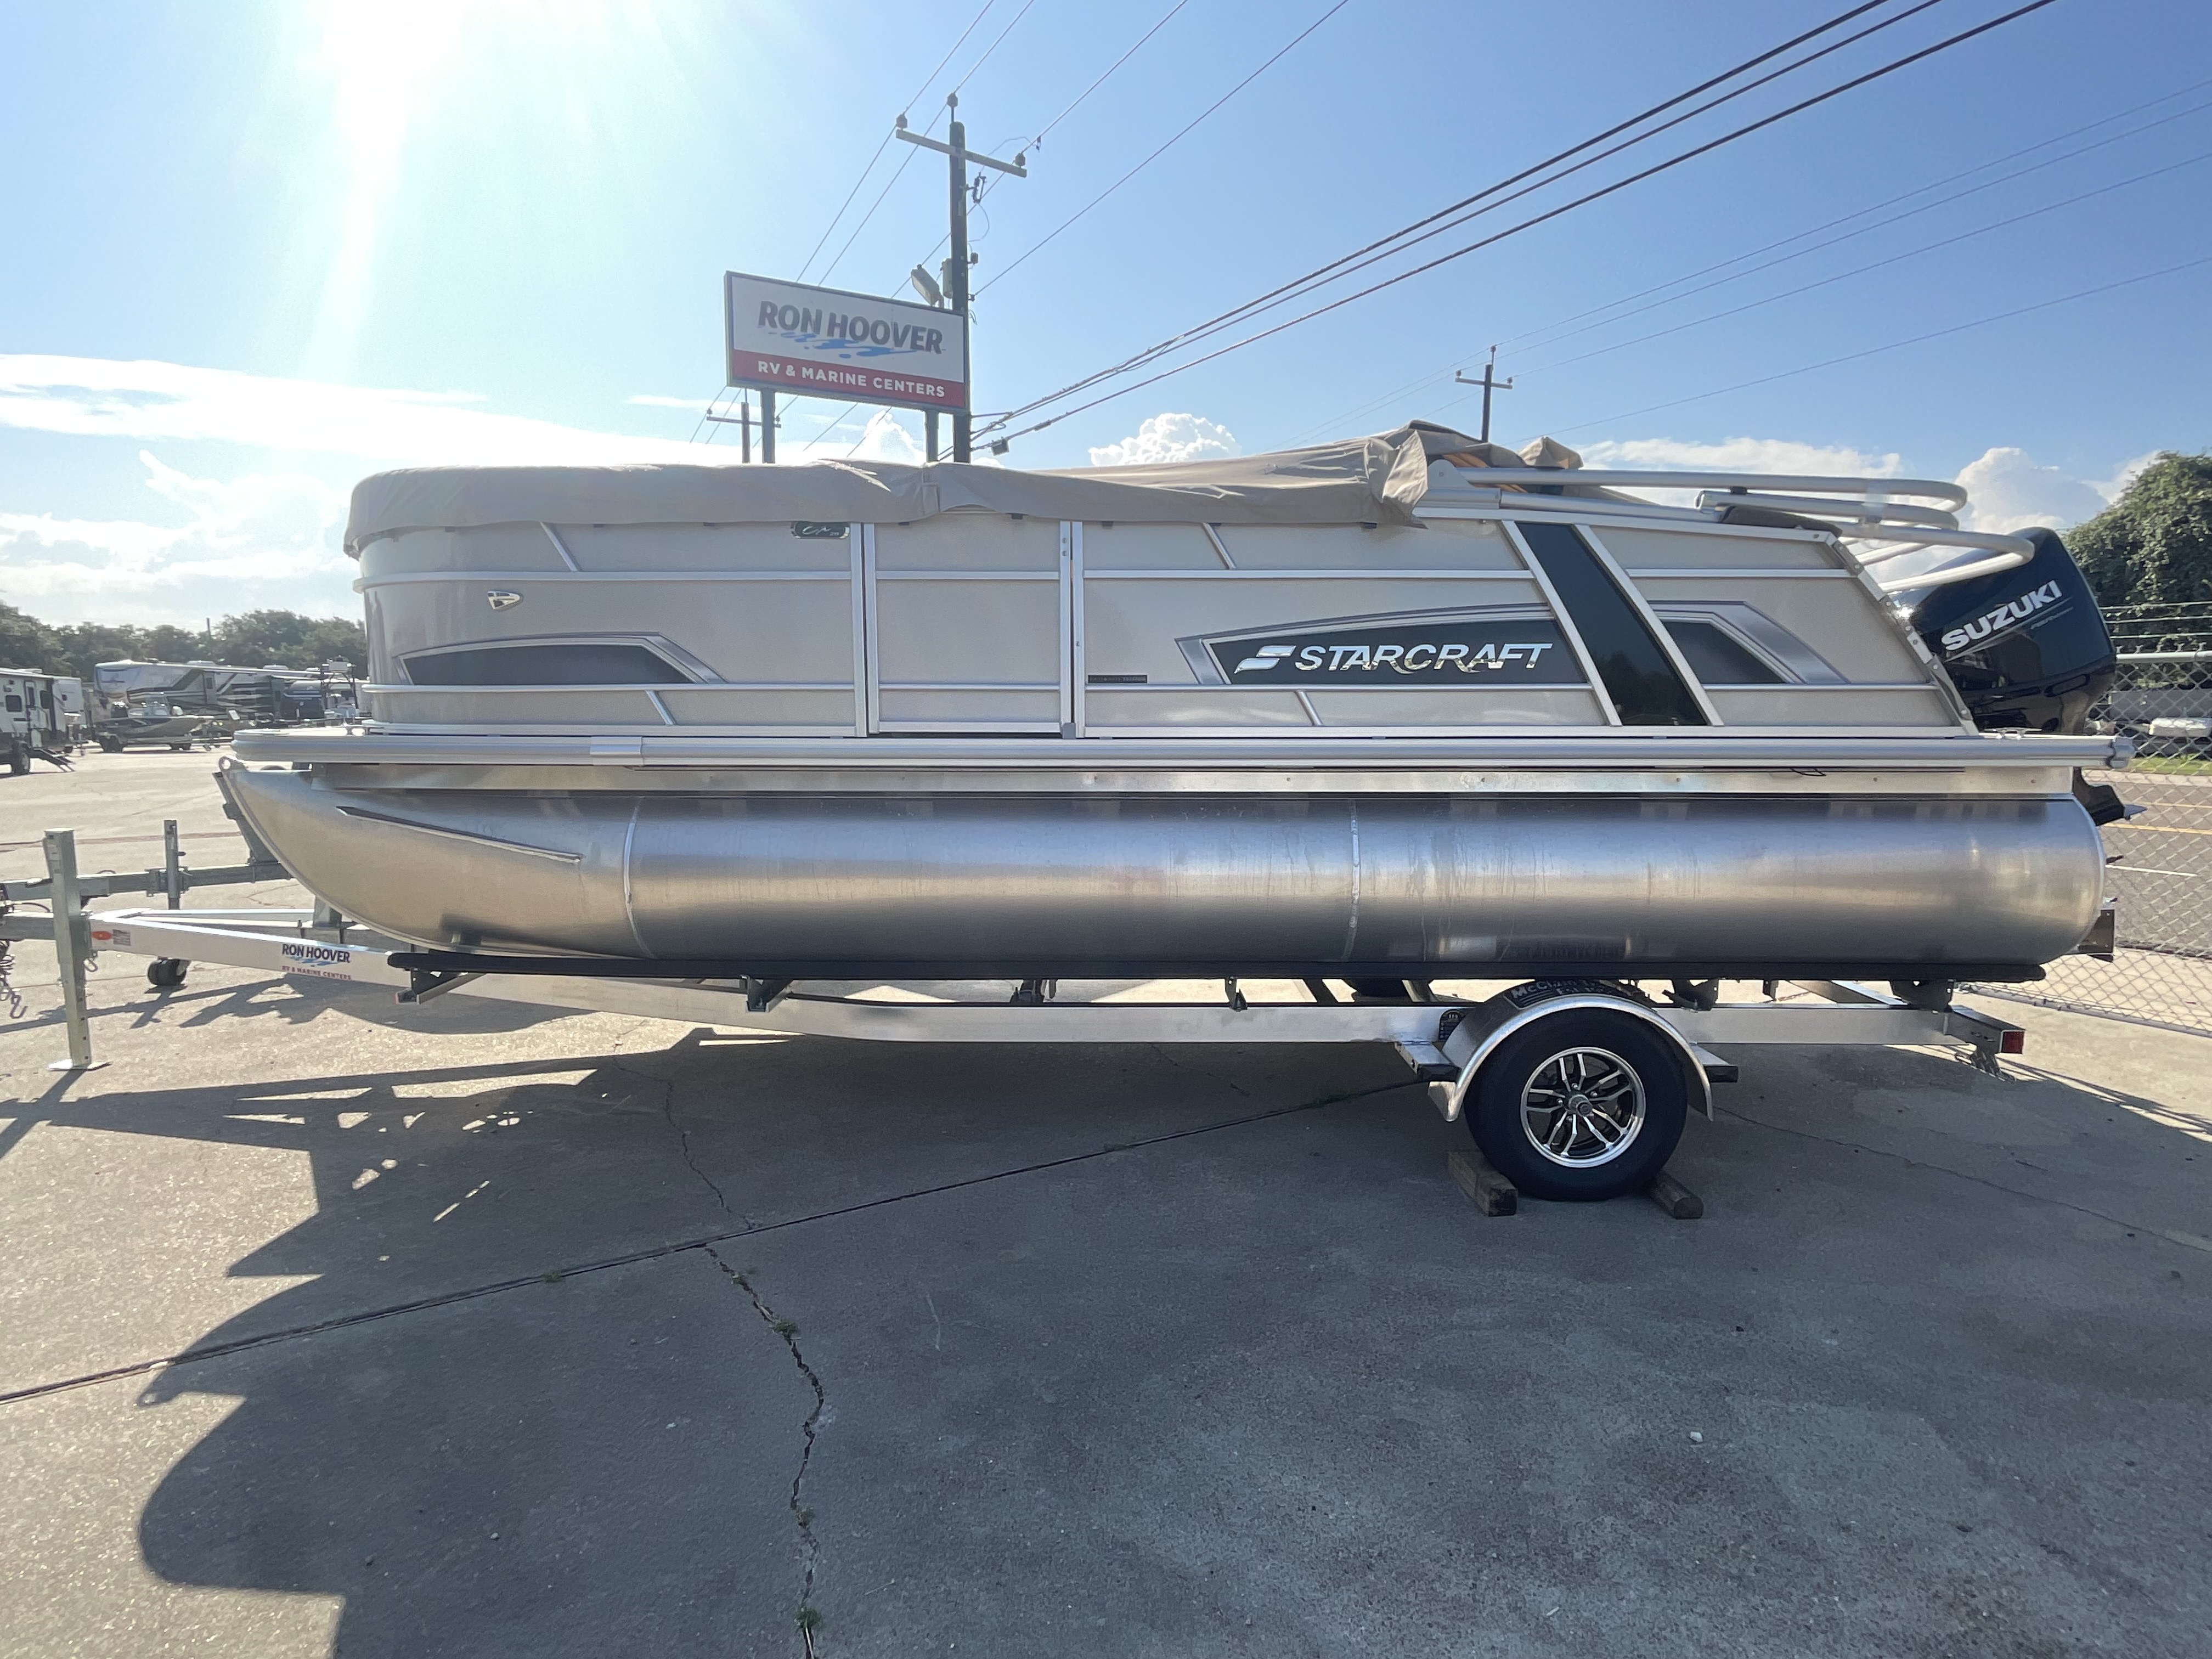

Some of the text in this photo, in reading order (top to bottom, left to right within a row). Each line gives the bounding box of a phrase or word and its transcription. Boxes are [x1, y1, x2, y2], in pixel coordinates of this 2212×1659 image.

[758, 301, 944, 354] RON HOOVER
[758, 360, 945, 397] RV & MARINE CENTERS
[1941, 579, 2063, 651] SUZUKI
[1295, 642, 1554, 675] STARCRAFT
[282, 944, 350, 963] RON HOOVER
[297, 968, 321, 977] MARINE
[323, 972, 352, 980] CENTERS
